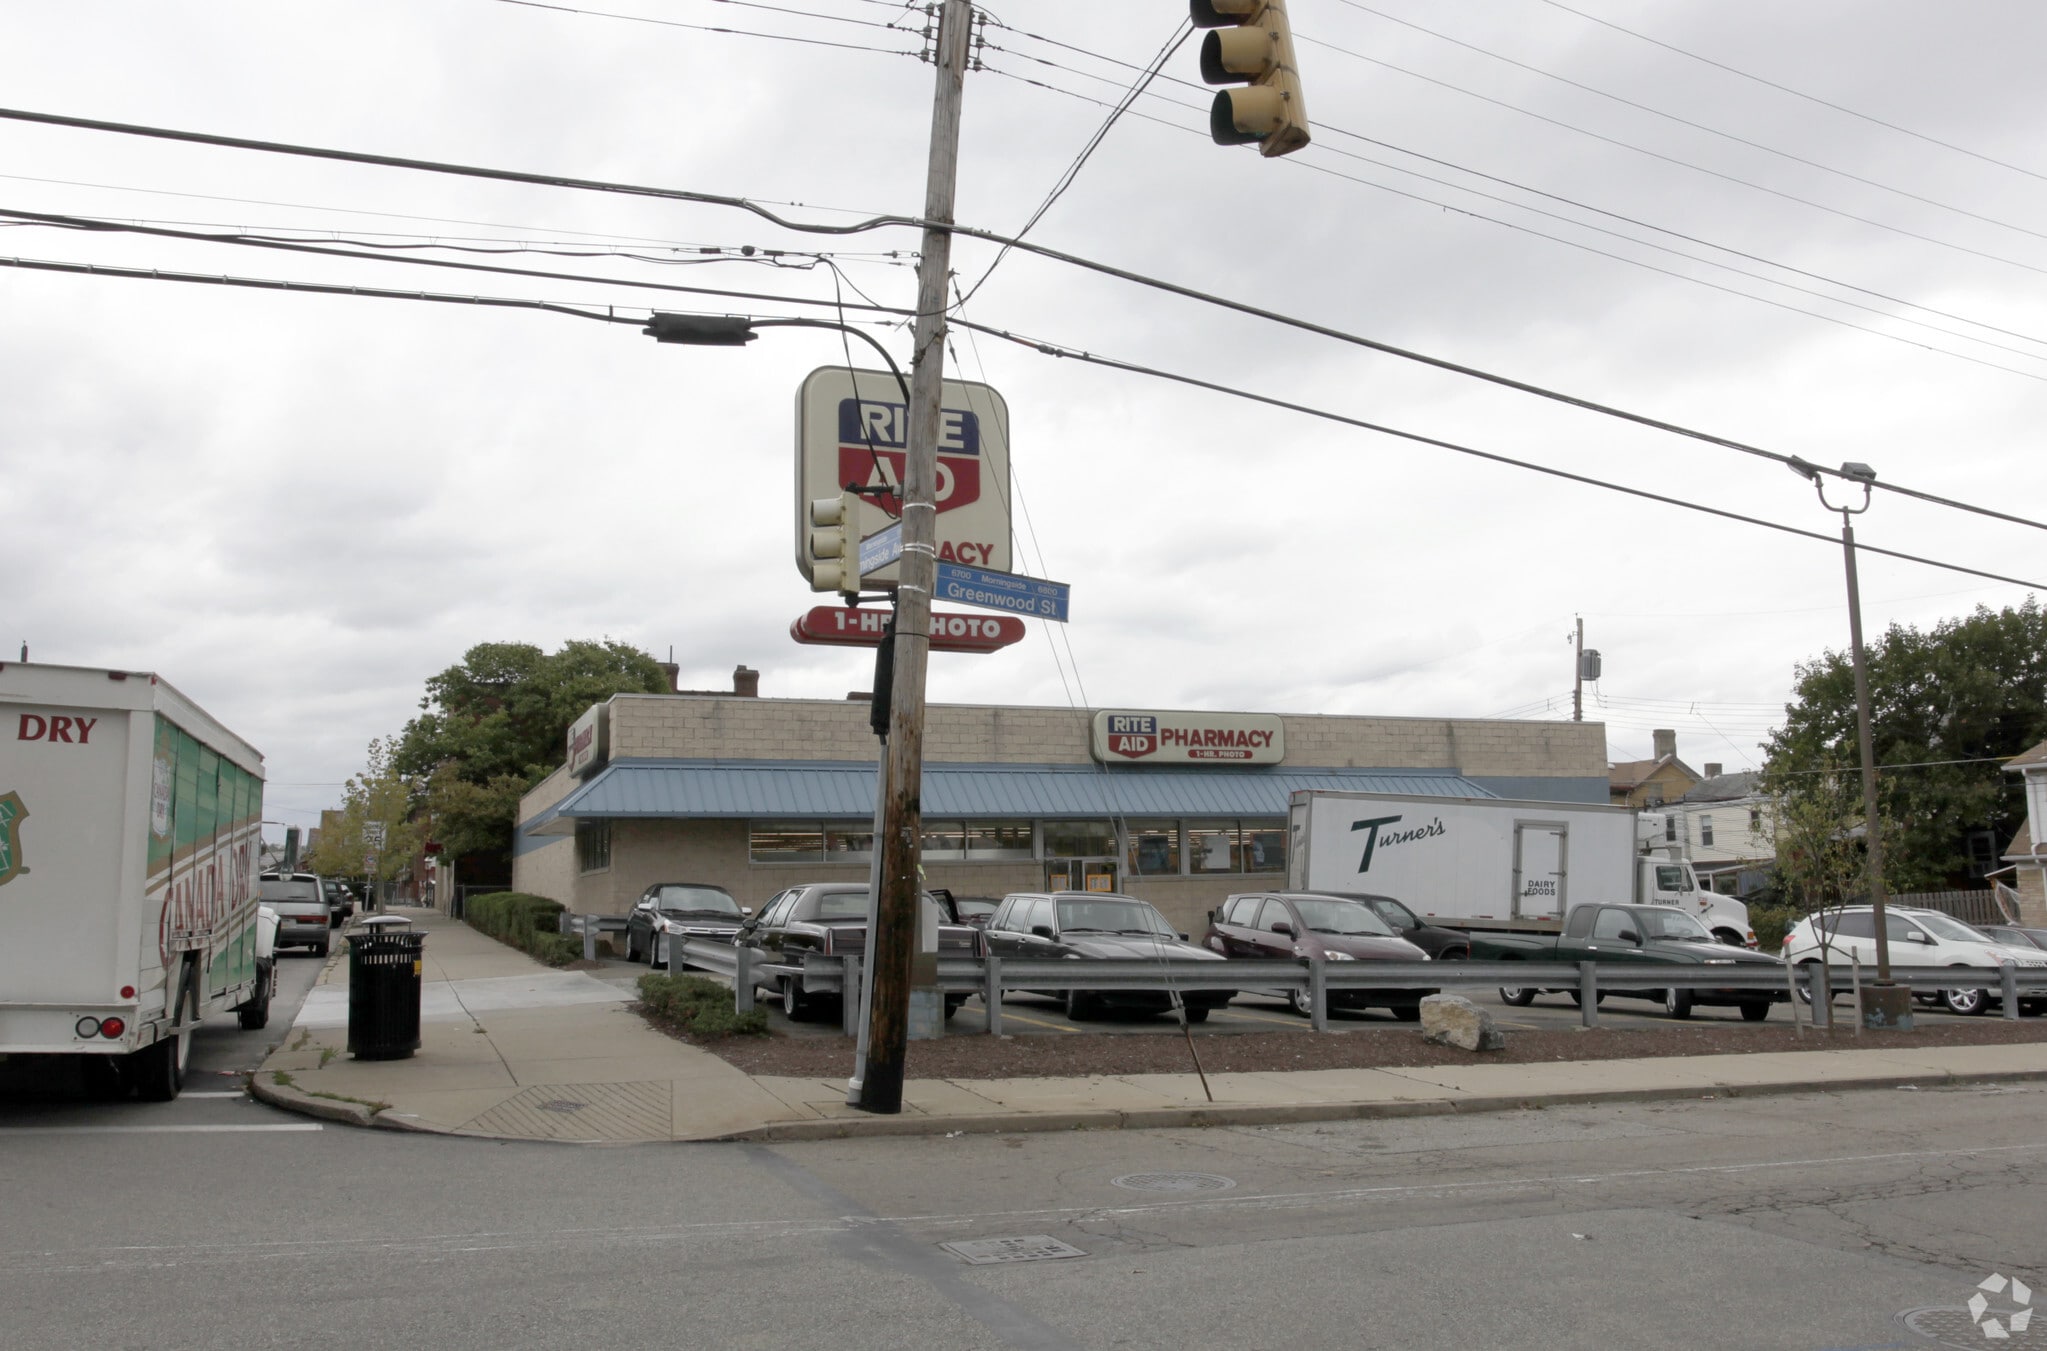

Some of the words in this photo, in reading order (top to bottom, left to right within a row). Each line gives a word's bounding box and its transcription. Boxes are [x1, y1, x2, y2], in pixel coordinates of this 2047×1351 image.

[860, 404, 964, 449] RIE
[865, 457, 955, 502] AD
[951, 569, 972, 580] 6700
[981, 575, 1027, 590] Morningside
[947, 582, 1035, 612] Greenwood
[1040, 599, 1057, 616] St
[930, 617, 1001, 638] HOTO
[17, 713, 98, 744] DRY
[1113, 716, 1152, 733] RITE
[1118, 736, 1149, 752] AID
[1160, 728, 1274, 749] PHARMACY
[1195, 750, 1217, 758] 1-HR.
[1218, 750, 1245, 758] PHOTO
[1350, 814, 1446, 874] Turner's
[1527, 880, 1556, 888] DAIRY
[1527, 887, 1556, 896] FOODS
[159, 854, 225, 971] CANADA
[231, 840, 253, 911] DRY
[1654, 898, 1680, 906] TURNER
